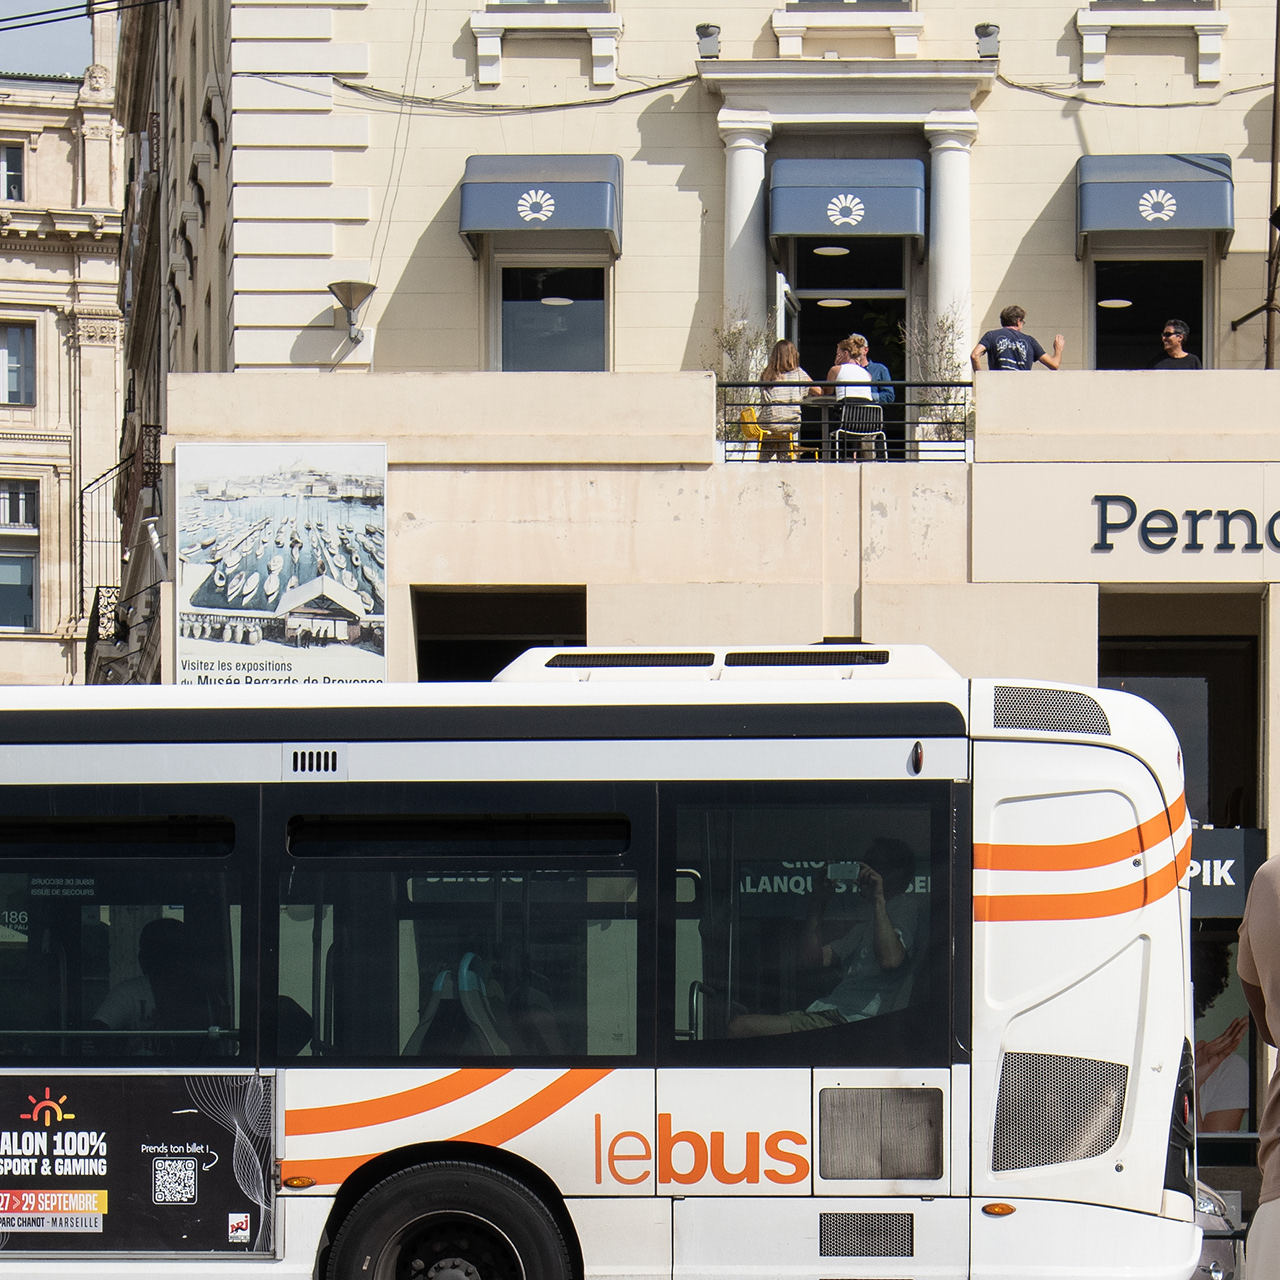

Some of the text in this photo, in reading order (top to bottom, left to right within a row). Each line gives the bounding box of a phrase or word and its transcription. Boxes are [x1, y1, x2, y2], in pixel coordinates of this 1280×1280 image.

[181, 659, 293, 673] Visitez les expositions
[197, 675, 240, 684] Musée
[31, 888, 94, 896] ISSUE DE SECOURS
[1, 910, 29, 924] 186
[53, 1131, 107, 1156] 100%
[141, 1142, 168, 1153] Prends
[170, 1143, 184, 1153] ton
[186, 1142, 204, 1153] billet
[595, 1113, 810, 1185] lebus
[40, 1158, 52, 1175] &
[54, 1158, 107, 1175] GAMING
[21, 1193, 35, 1211] 29
[37, 1193, 98, 1211] SEPTEMBRE
[17, 1217, 45, 1227] CHANOT
[51, 1217, 98, 1227] MARSEILLE
